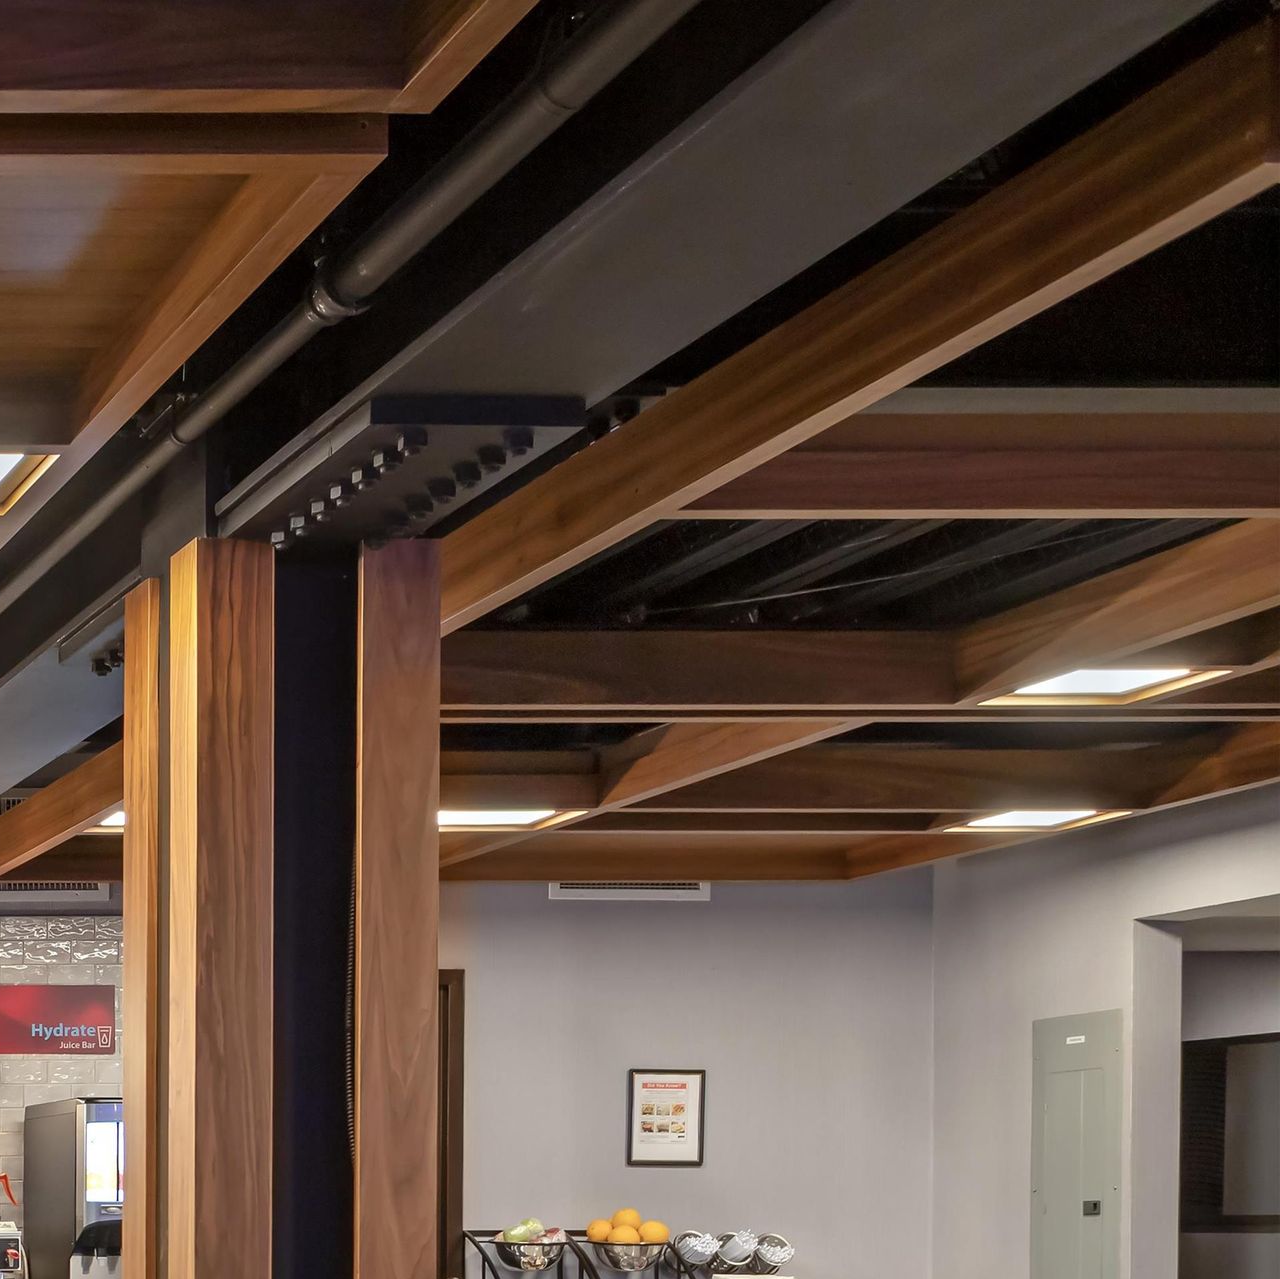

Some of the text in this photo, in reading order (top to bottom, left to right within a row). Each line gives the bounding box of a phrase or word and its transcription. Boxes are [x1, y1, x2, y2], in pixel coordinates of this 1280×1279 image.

[31, 1022, 96, 1041] Hydrate
[59, 1041, 96, 1049] Juice Bar
